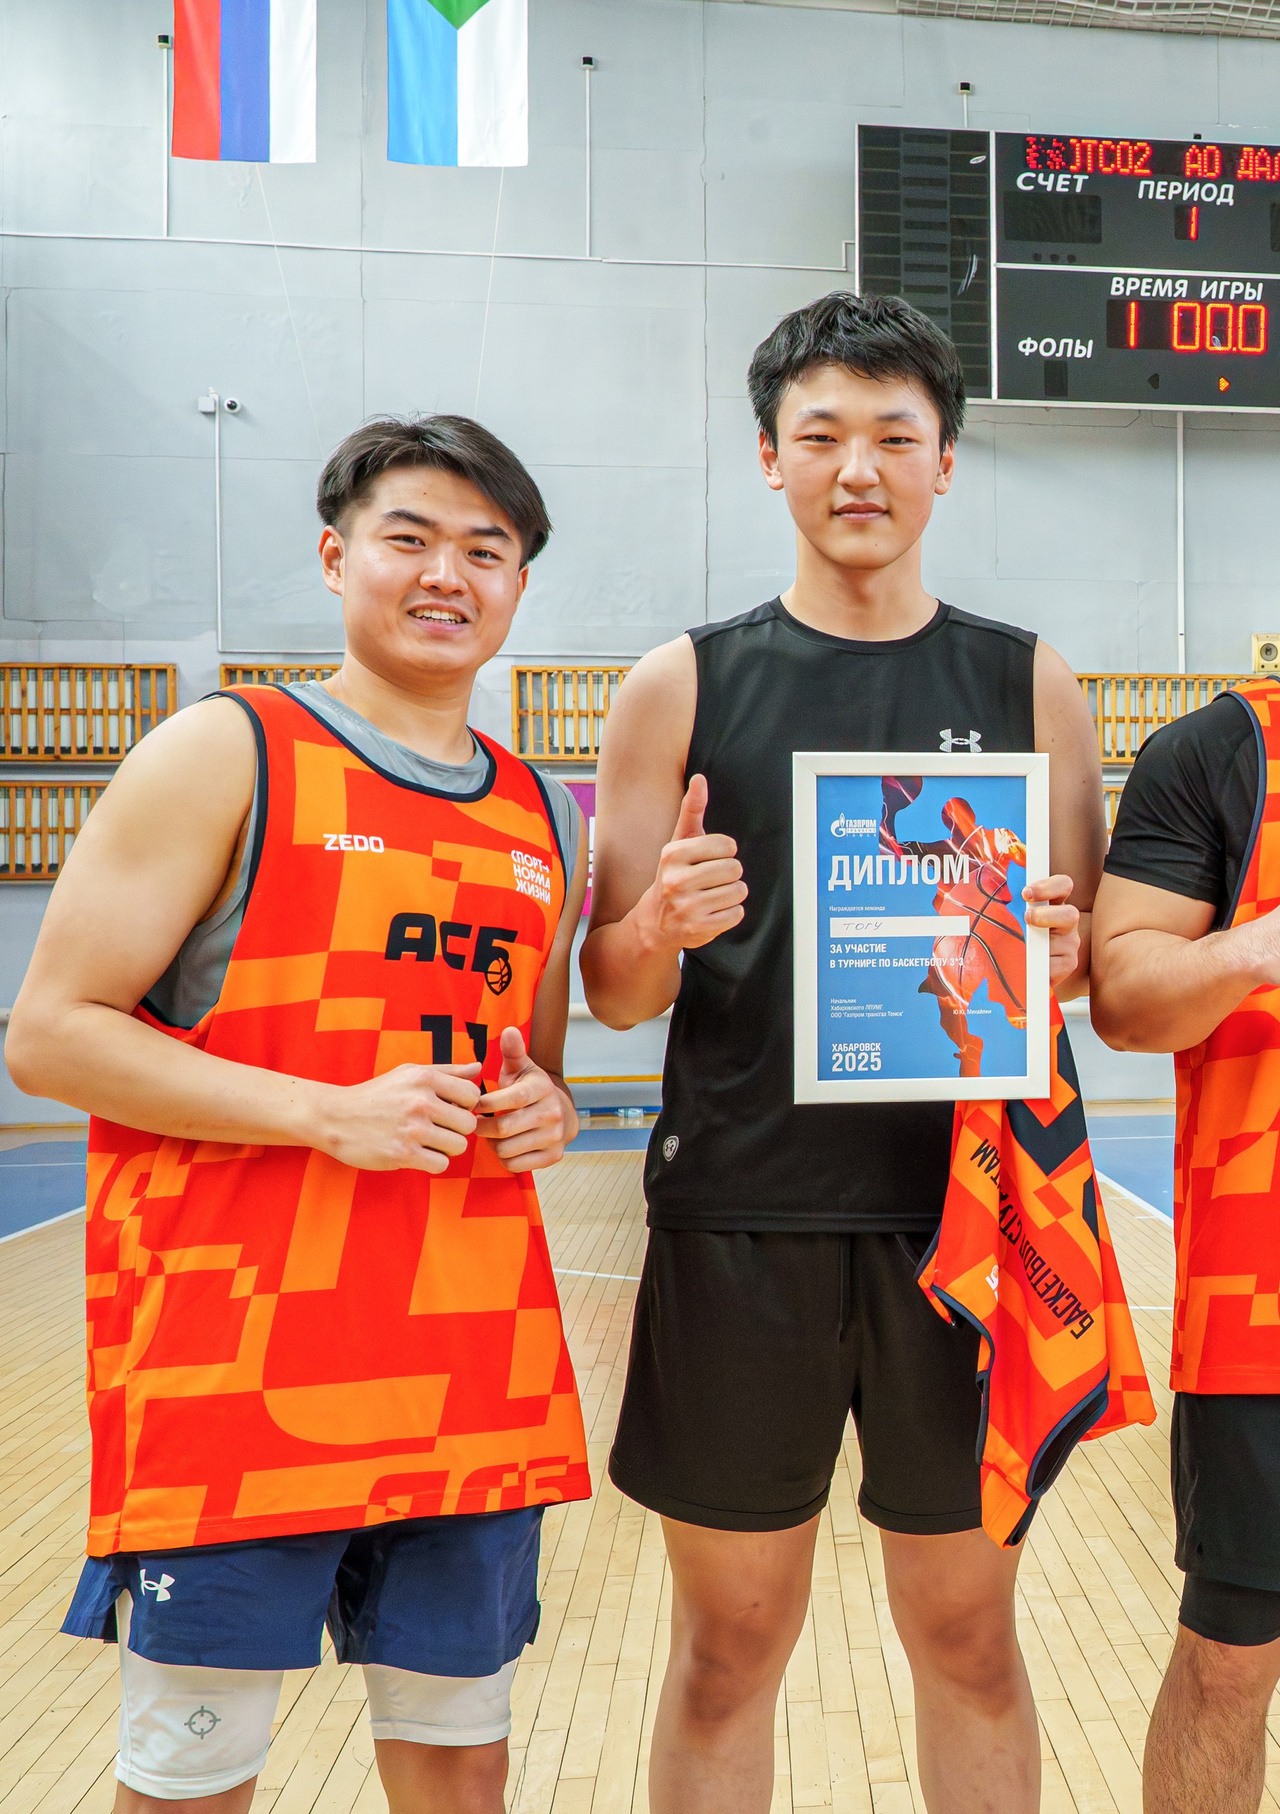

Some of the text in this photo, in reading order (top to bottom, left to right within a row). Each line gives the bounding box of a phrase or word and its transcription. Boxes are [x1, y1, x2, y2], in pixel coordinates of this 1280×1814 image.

[1016, 172, 1089, 193] СЧЕТ
[1138, 180, 1235, 206] ПЕРИОД
[1189, 206, 1199, 241] 1
[1110, 275, 1264, 301] ВРЕМЯ ИГРЫ
[1018, 337, 1094, 359] ФОЛЫ
[323, 833, 385, 853] ZEDO
[510, 849, 544, 872] СПОРТ
[513, 863, 551, 891] НОРМА
[828, 854, 970, 892] ДИПЛОМ
[515, 878, 551, 906] ЖИЗНИ
[386, 912, 519, 979] АСБ
[829, 943, 887, 954] ЗА УЧАСТИЕ
[830, 960, 836, 969] В
[838, 959, 877, 968] ТУРНИРЕ
[879, 959, 891, 968] ПО
[892, 957, 948, 968] БАСКЕТБОЛУ
[831, 1042, 882, 1053] ХАБАРОВСК
[831, 1051, 883, 1073] 2025
